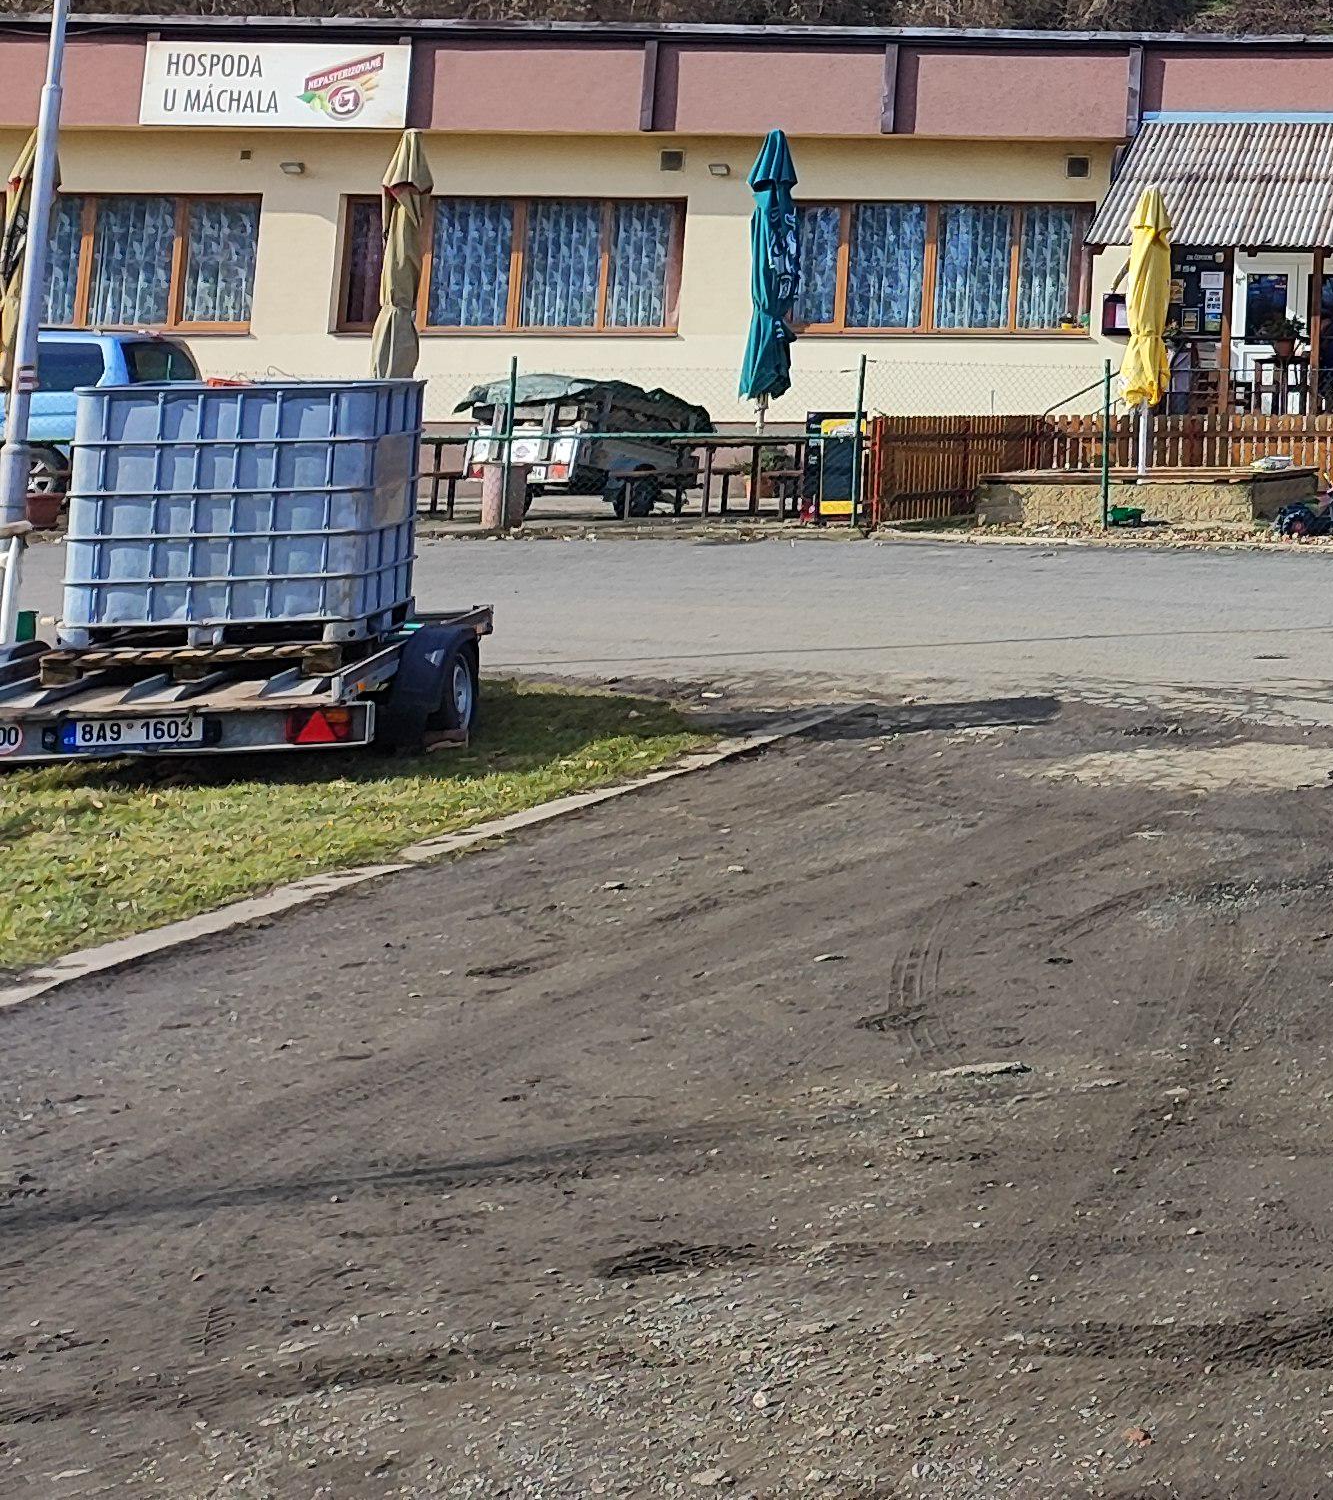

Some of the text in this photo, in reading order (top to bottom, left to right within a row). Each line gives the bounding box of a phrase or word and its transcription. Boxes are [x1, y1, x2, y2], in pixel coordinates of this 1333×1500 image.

[166, 53, 263, 78] HOSPODA
[163, 83, 279, 113] U MÁCHALA
[81, 723, 122, 743] 8A9
[140, 719, 193, 741] 1603
